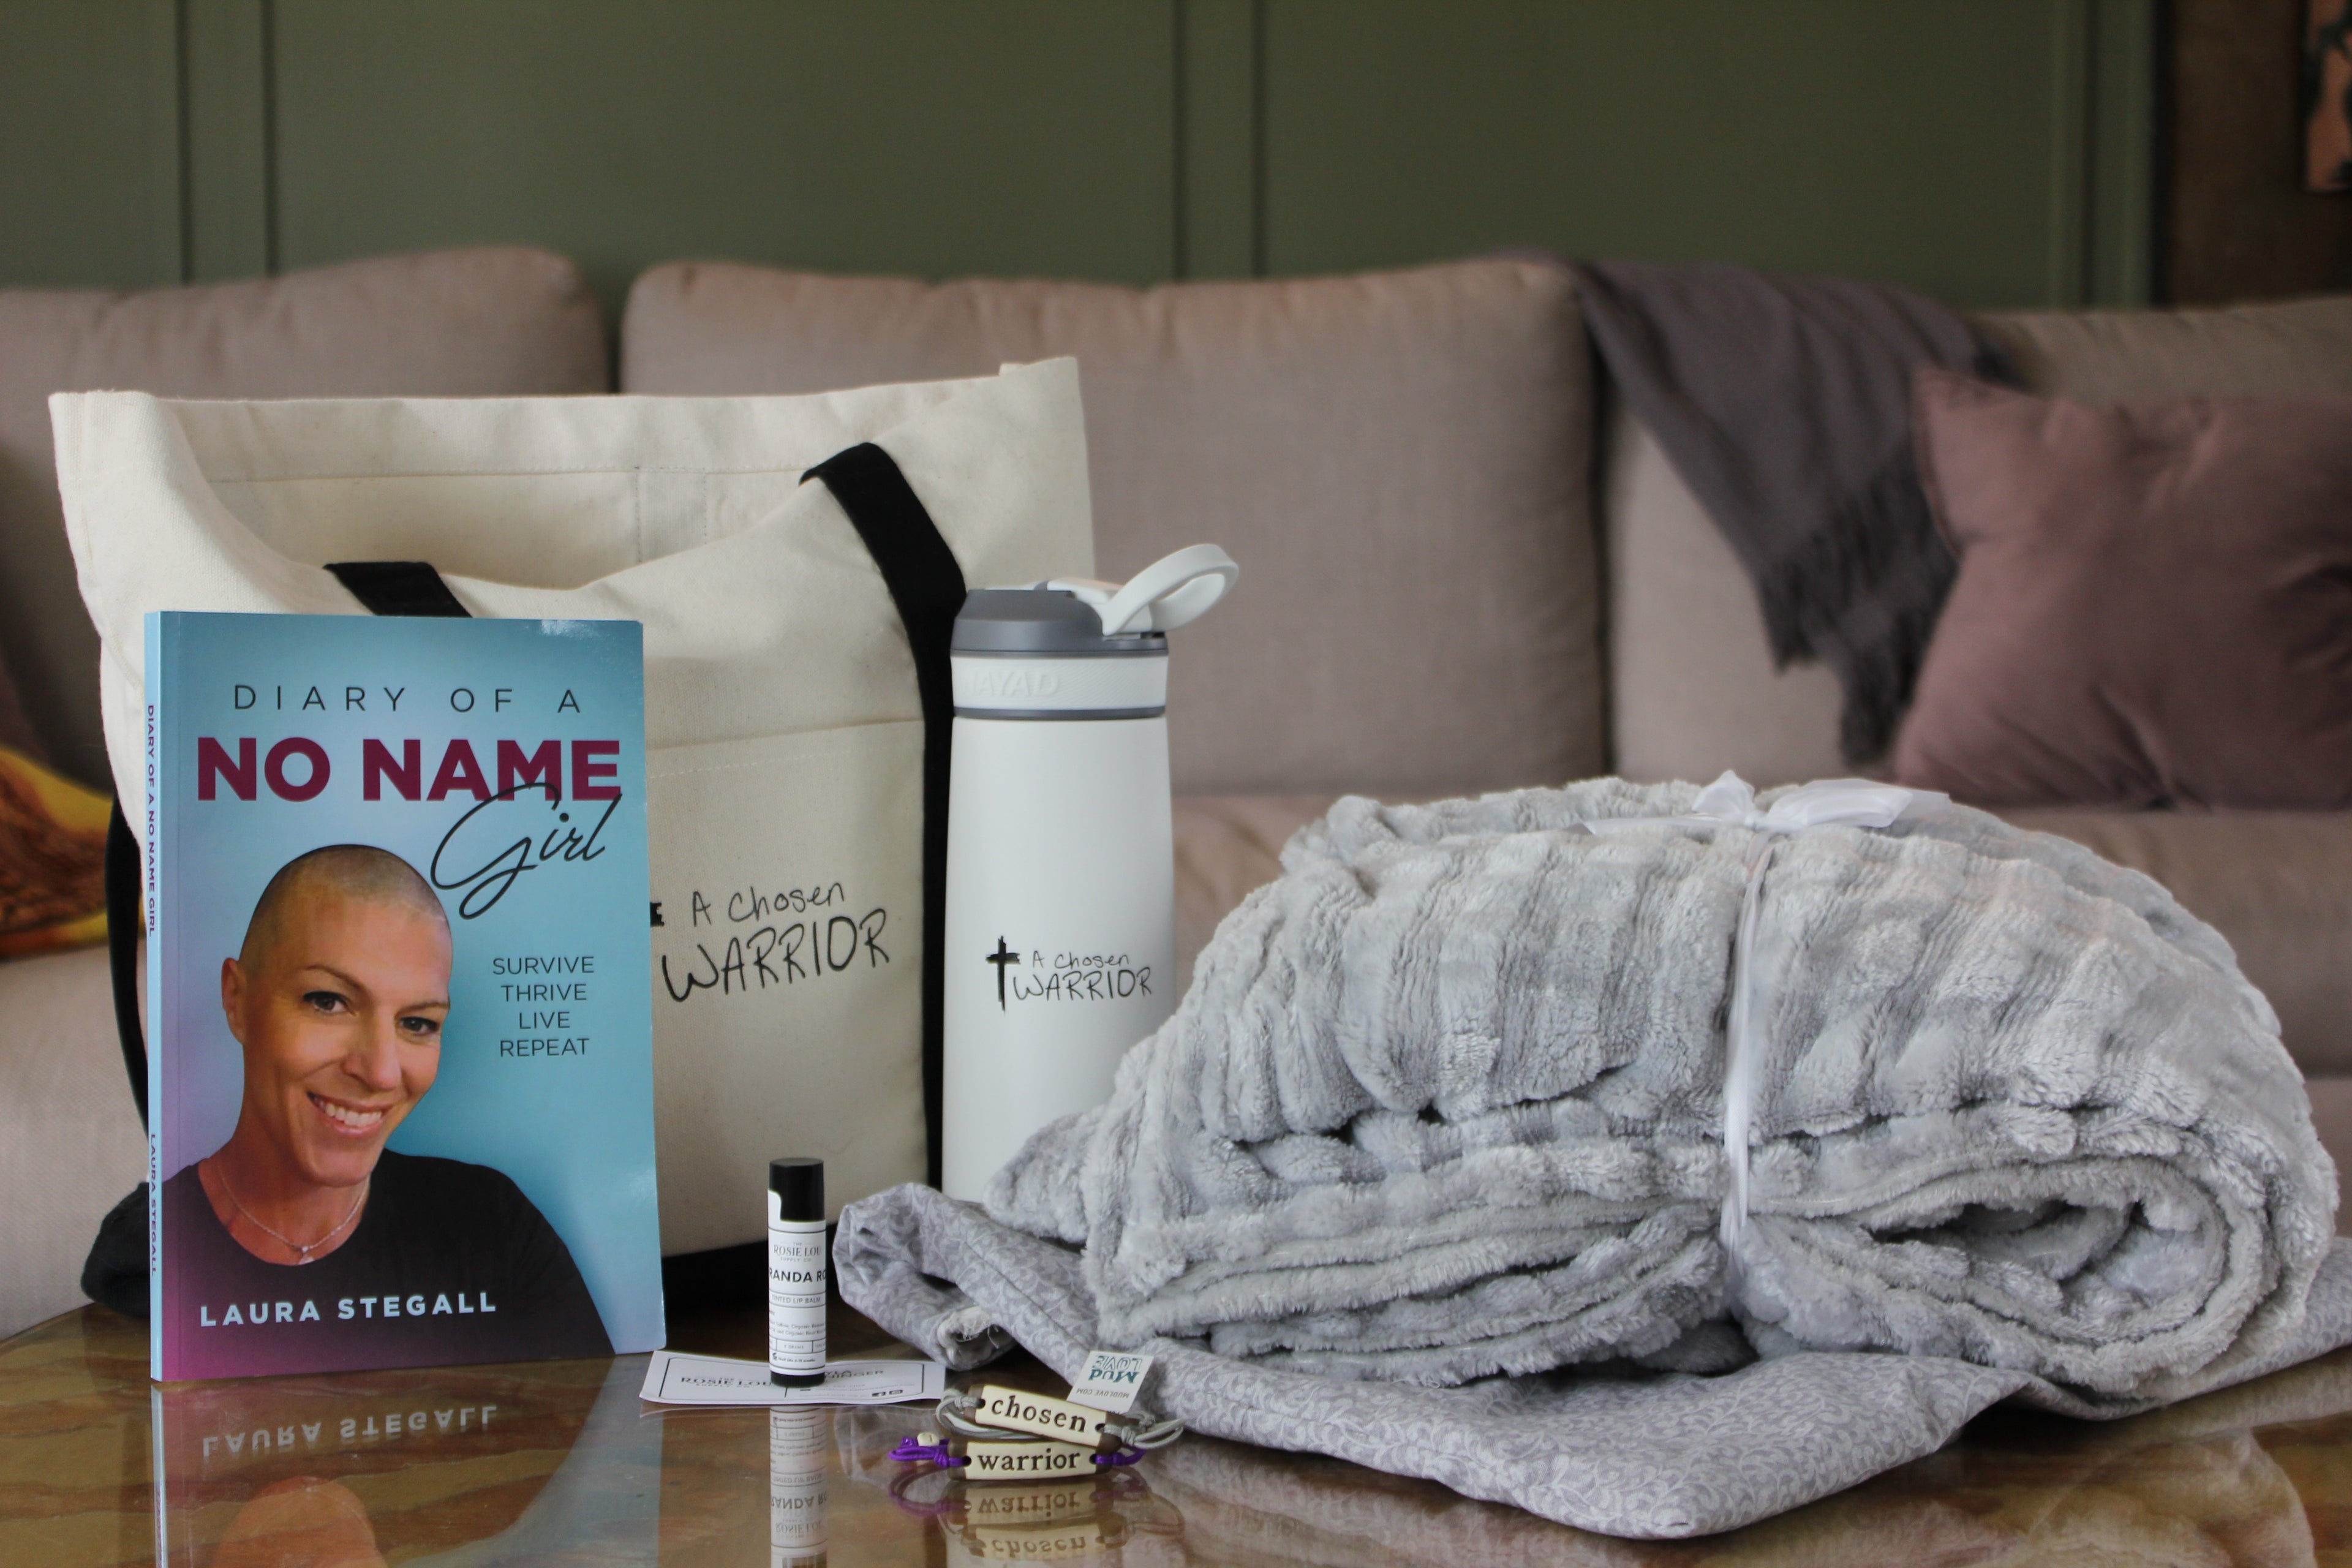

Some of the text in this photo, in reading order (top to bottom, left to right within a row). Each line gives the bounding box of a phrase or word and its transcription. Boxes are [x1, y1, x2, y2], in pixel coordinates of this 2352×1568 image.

[235, 684, 581, 714] DIARY OF A
[148, 764, 154, 788] OF
[197, 737, 622, 802] NO NAME
[148, 794, 154, 804] A
[149, 810, 154, 835] NO
[431, 782, 622, 919] Girl
[692, 891, 712, 927] A
[492, 956, 595, 975] SURVIVE
[662, 908, 890, 1003] WARRIOR
[1032, 951, 1045, 968] A
[501, 984, 587, 1002] THRIVE
[1014, 966, 1153, 1001] WARRIOR
[518, 1011, 571, 1030] LIVE
[499, 1038, 590, 1057] REPEAT
[774, 1245, 821, 1257] ROSIE LOU
[200, 1292, 496, 1327] LAURA STEGALL
[772, 1294, 791, 1303] TINTED
[1092, 1355, 1142, 1371] LOVE
[1088, 1369, 1140, 1384] Mud
[992, 1395, 1086, 1433] chosen
[978, 1448, 1080, 1472] warrior
